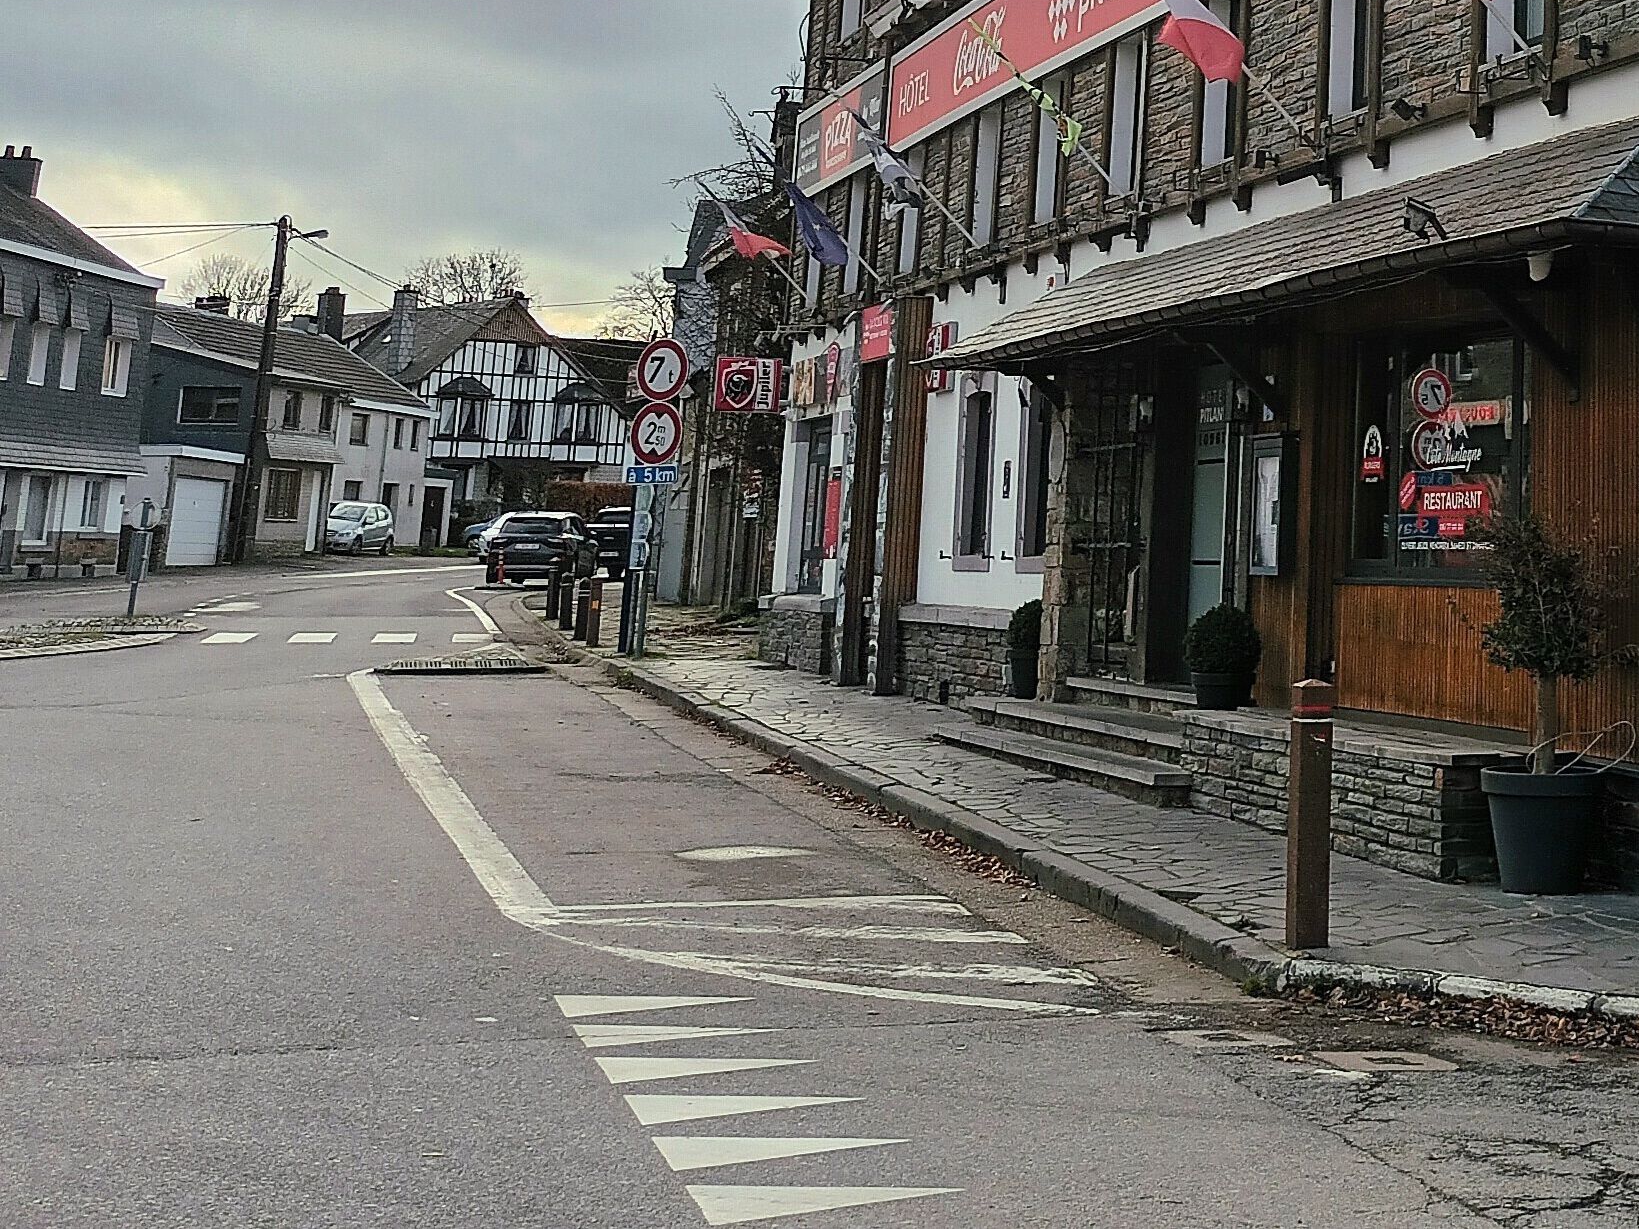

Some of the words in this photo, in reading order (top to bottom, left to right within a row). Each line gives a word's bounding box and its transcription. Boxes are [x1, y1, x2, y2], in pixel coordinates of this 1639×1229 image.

[898, 69, 931, 118] HÔTEL
[825, 110, 853, 160] PIZZA
[648, 356, 666, 383] 7
[668, 369, 674, 383] t
[757, 361, 772, 408] Jupiler
[644, 421, 658, 445] 2
[644, 468, 653, 482] 5
[656, 467, 675, 482] km
[1424, 491, 1482, 511] RESTAURANT
